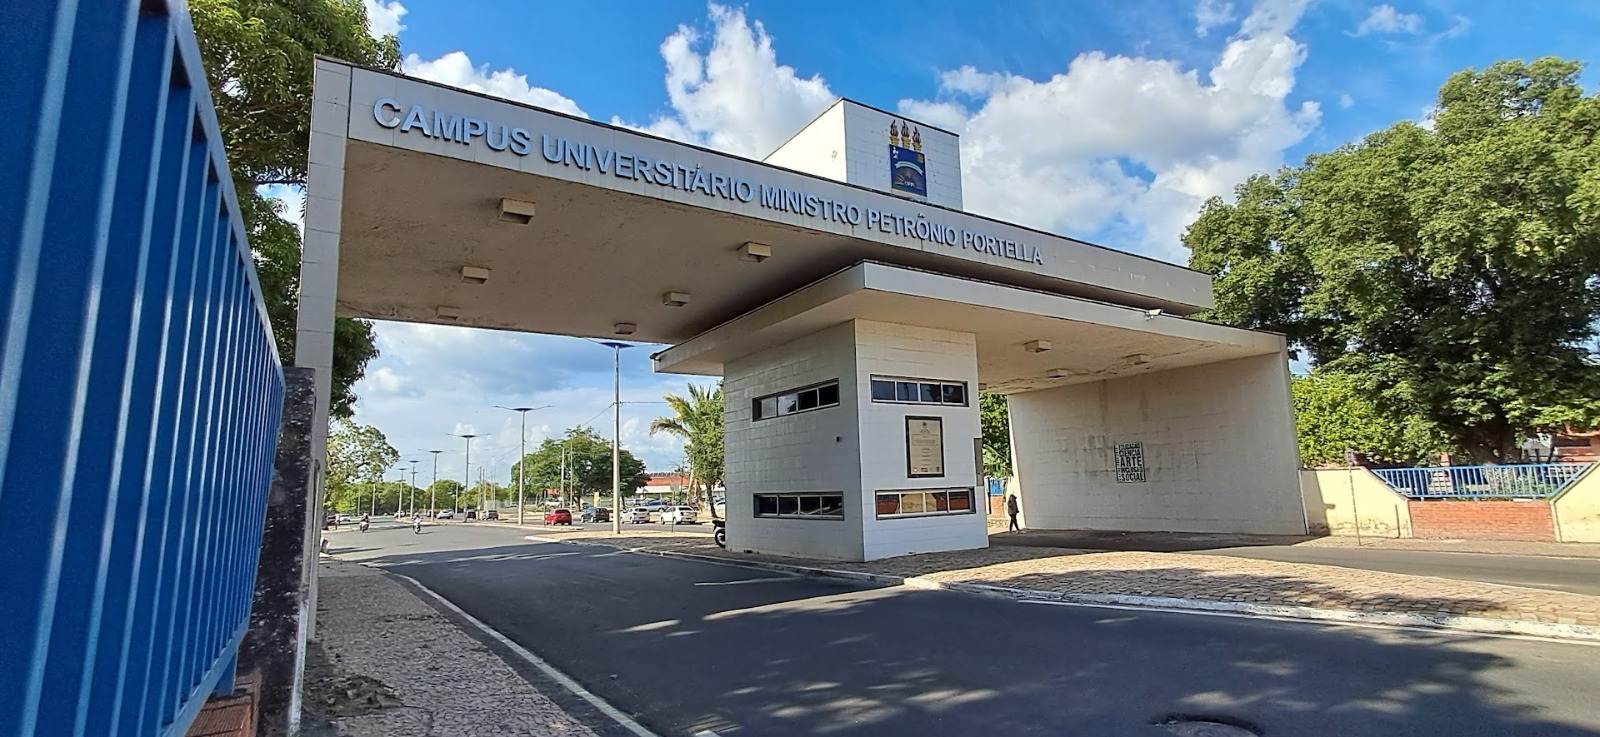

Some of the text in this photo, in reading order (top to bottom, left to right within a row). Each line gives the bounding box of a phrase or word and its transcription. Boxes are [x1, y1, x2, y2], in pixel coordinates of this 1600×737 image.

[373, 97, 1043, 265] CAMPUS UNIVERSITÁRIO MINISTRO PETRÔNIO PORTELLA
[1121, 456, 1142, 467] ARTE
[1121, 472, 1144, 481] SOCIAL
